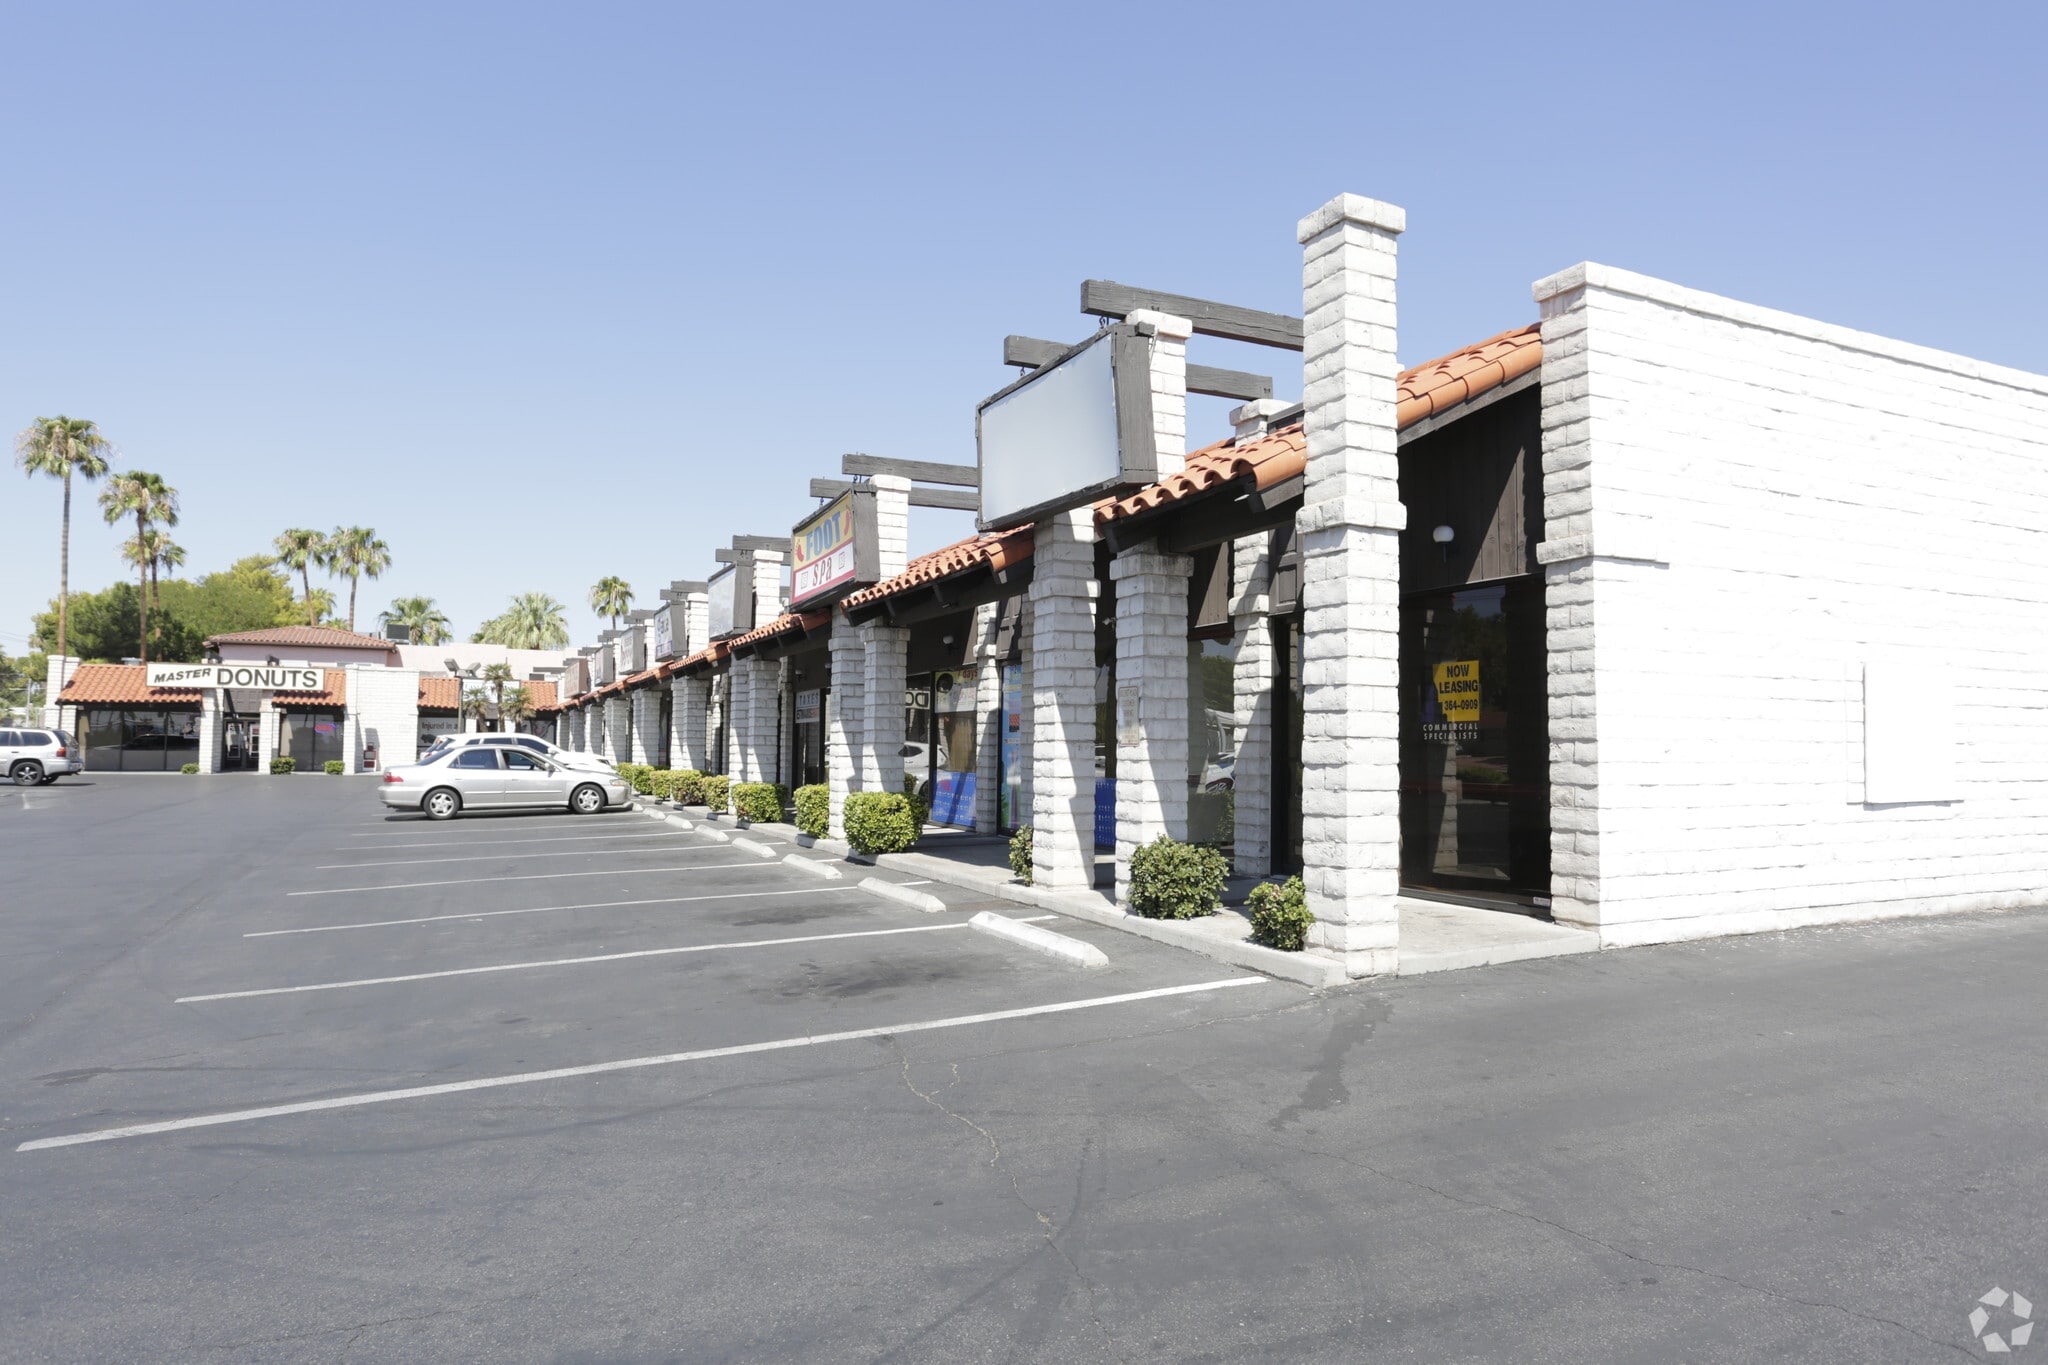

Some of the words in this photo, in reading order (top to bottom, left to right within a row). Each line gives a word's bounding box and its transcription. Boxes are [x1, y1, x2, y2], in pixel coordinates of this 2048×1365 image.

[805, 511, 841, 561] FOOT
[1447, 664, 1470, 677] NOW
[154, 668, 211, 683] MASTER
[217, 668, 317, 688] DONUTS
[1440, 680, 1478, 693] LEASING
[800, 692, 818, 706] TAXES
[422, 721, 445, 731] Injured
[1423, 723, 1478, 731] COMMERCIAL
[1424, 732, 1478, 740] SPECIALISTS
